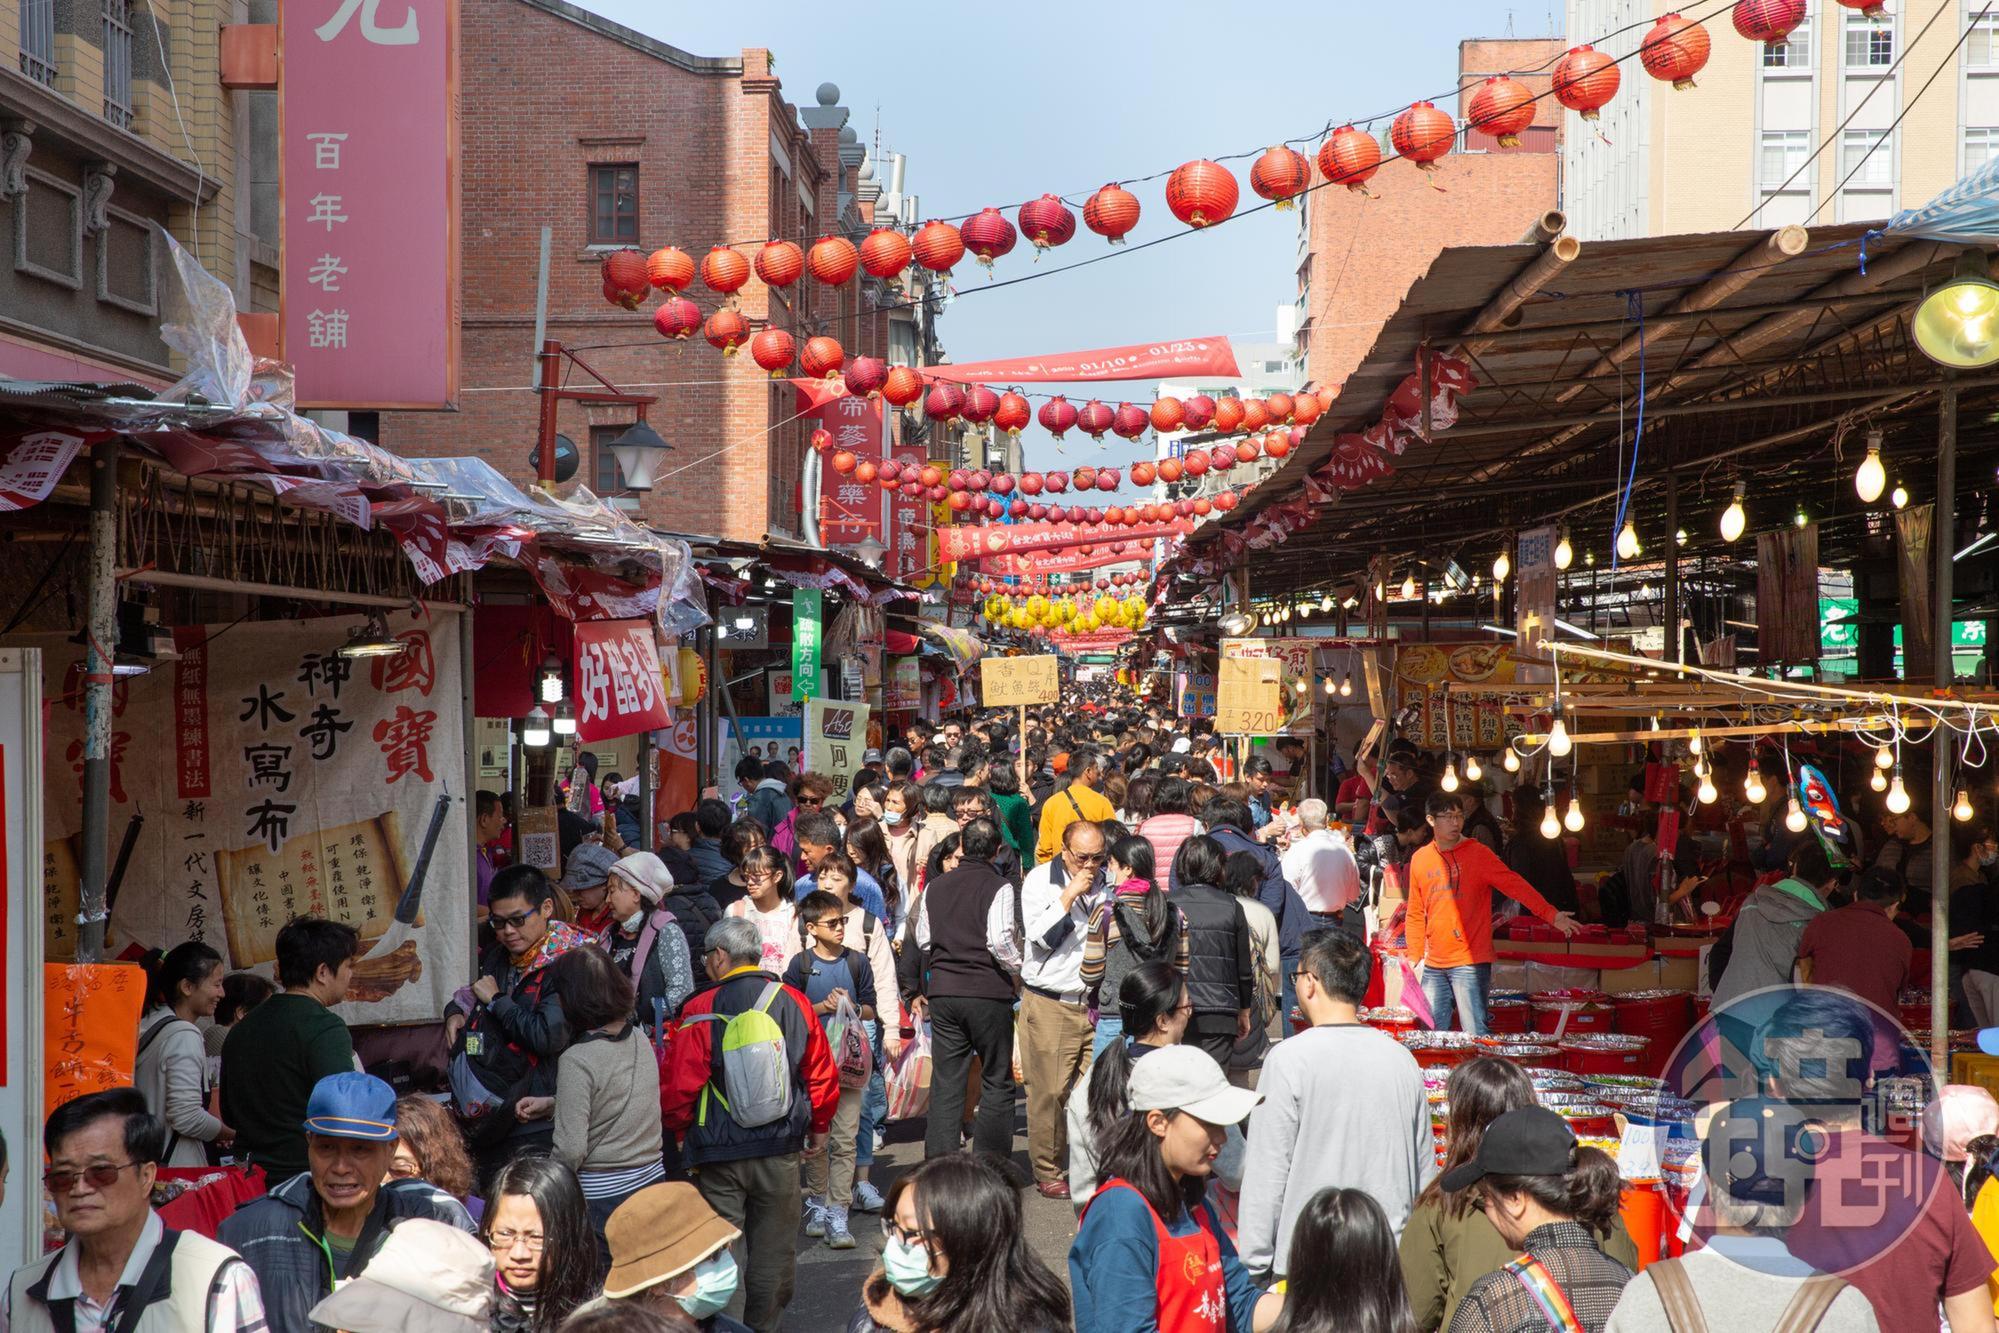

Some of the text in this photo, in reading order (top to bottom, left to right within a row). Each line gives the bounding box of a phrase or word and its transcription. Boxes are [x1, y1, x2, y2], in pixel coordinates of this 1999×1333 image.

[306, 132, 349, 349] 百年老舖
[1080, 357, 1126, 371] 01/10
[1149, 341, 1196, 356] 01/23
[799, 617, 815, 678] 疏散方向
[1039, 690, 1058, 701] 400
[1188, 673, 1212, 687] 100
[181, 648, 205, 790] 無紙無墨練書法
[297, 653, 354, 761] 神奇
[1239, 712, 1275, 732] 320
